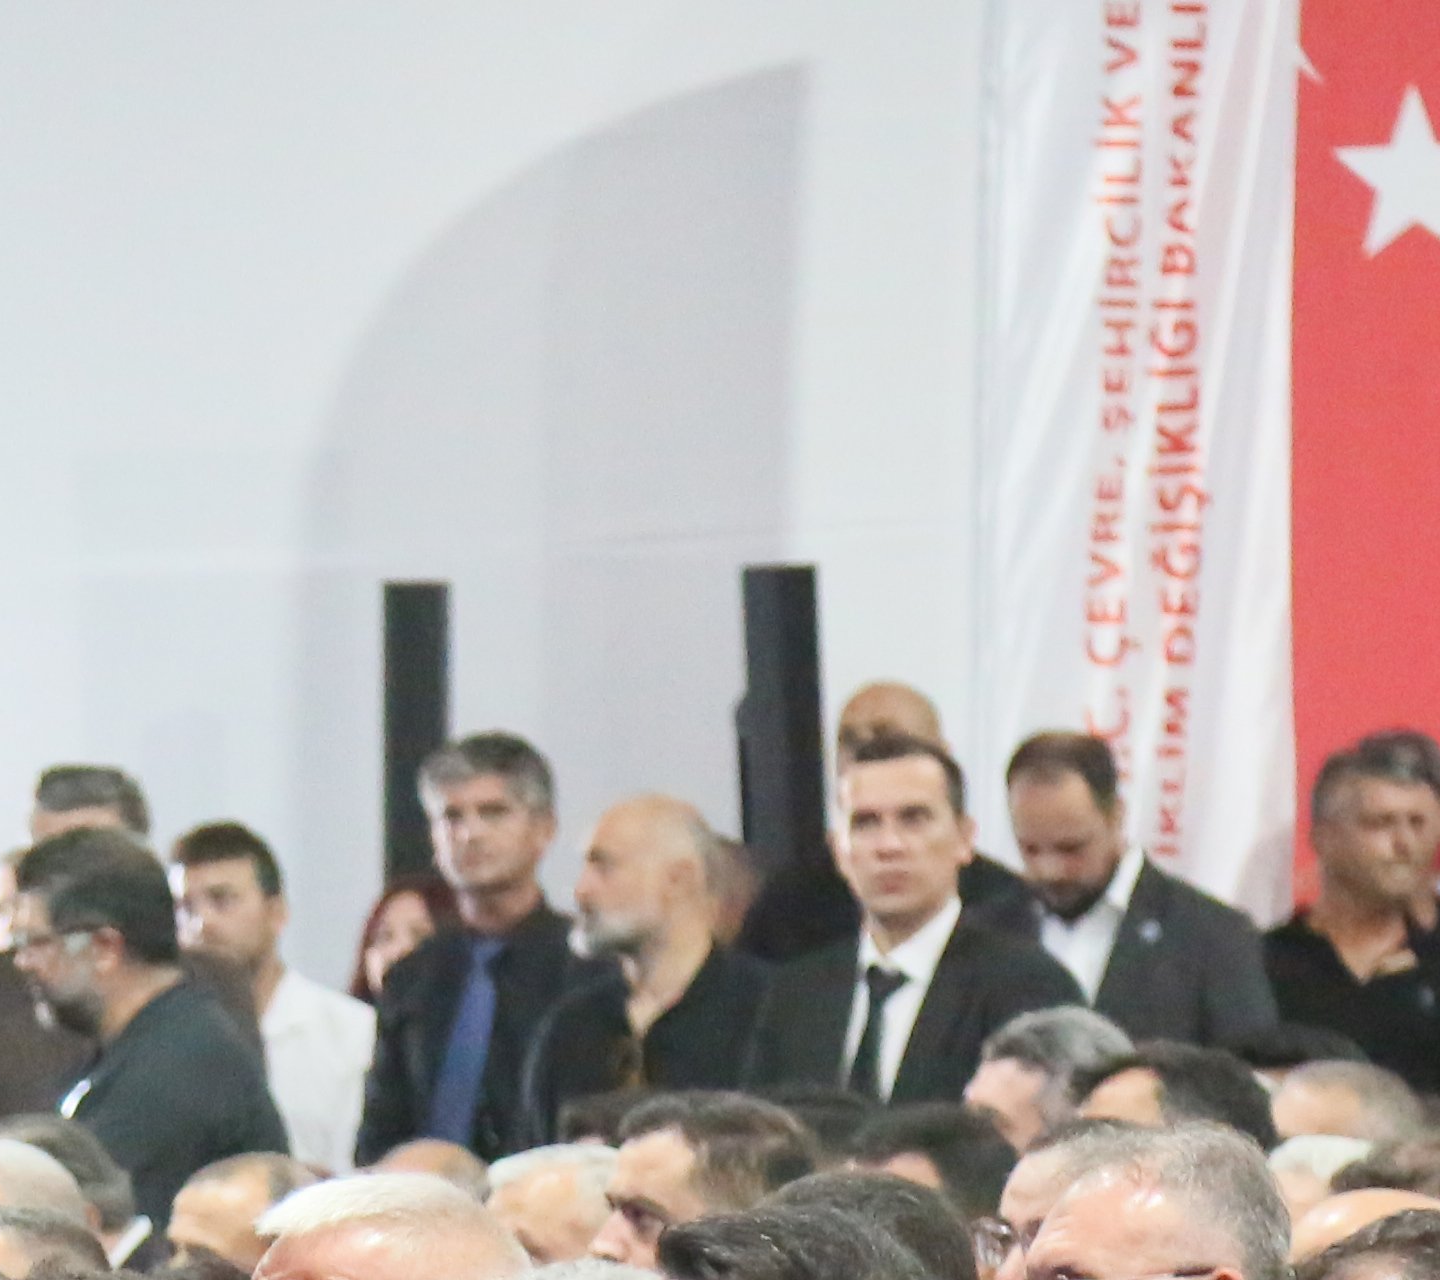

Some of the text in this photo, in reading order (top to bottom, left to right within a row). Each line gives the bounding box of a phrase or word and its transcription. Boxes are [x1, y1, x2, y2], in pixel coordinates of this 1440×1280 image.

[1094, 96, 1141, 432] ŞEHİRCİLİK
[1148, 299, 1211, 663] DEĞİŞİKLİĞİ
[1084, 686, 1132, 781] .C.
[1154, 687, 1189, 856] İKLİM
